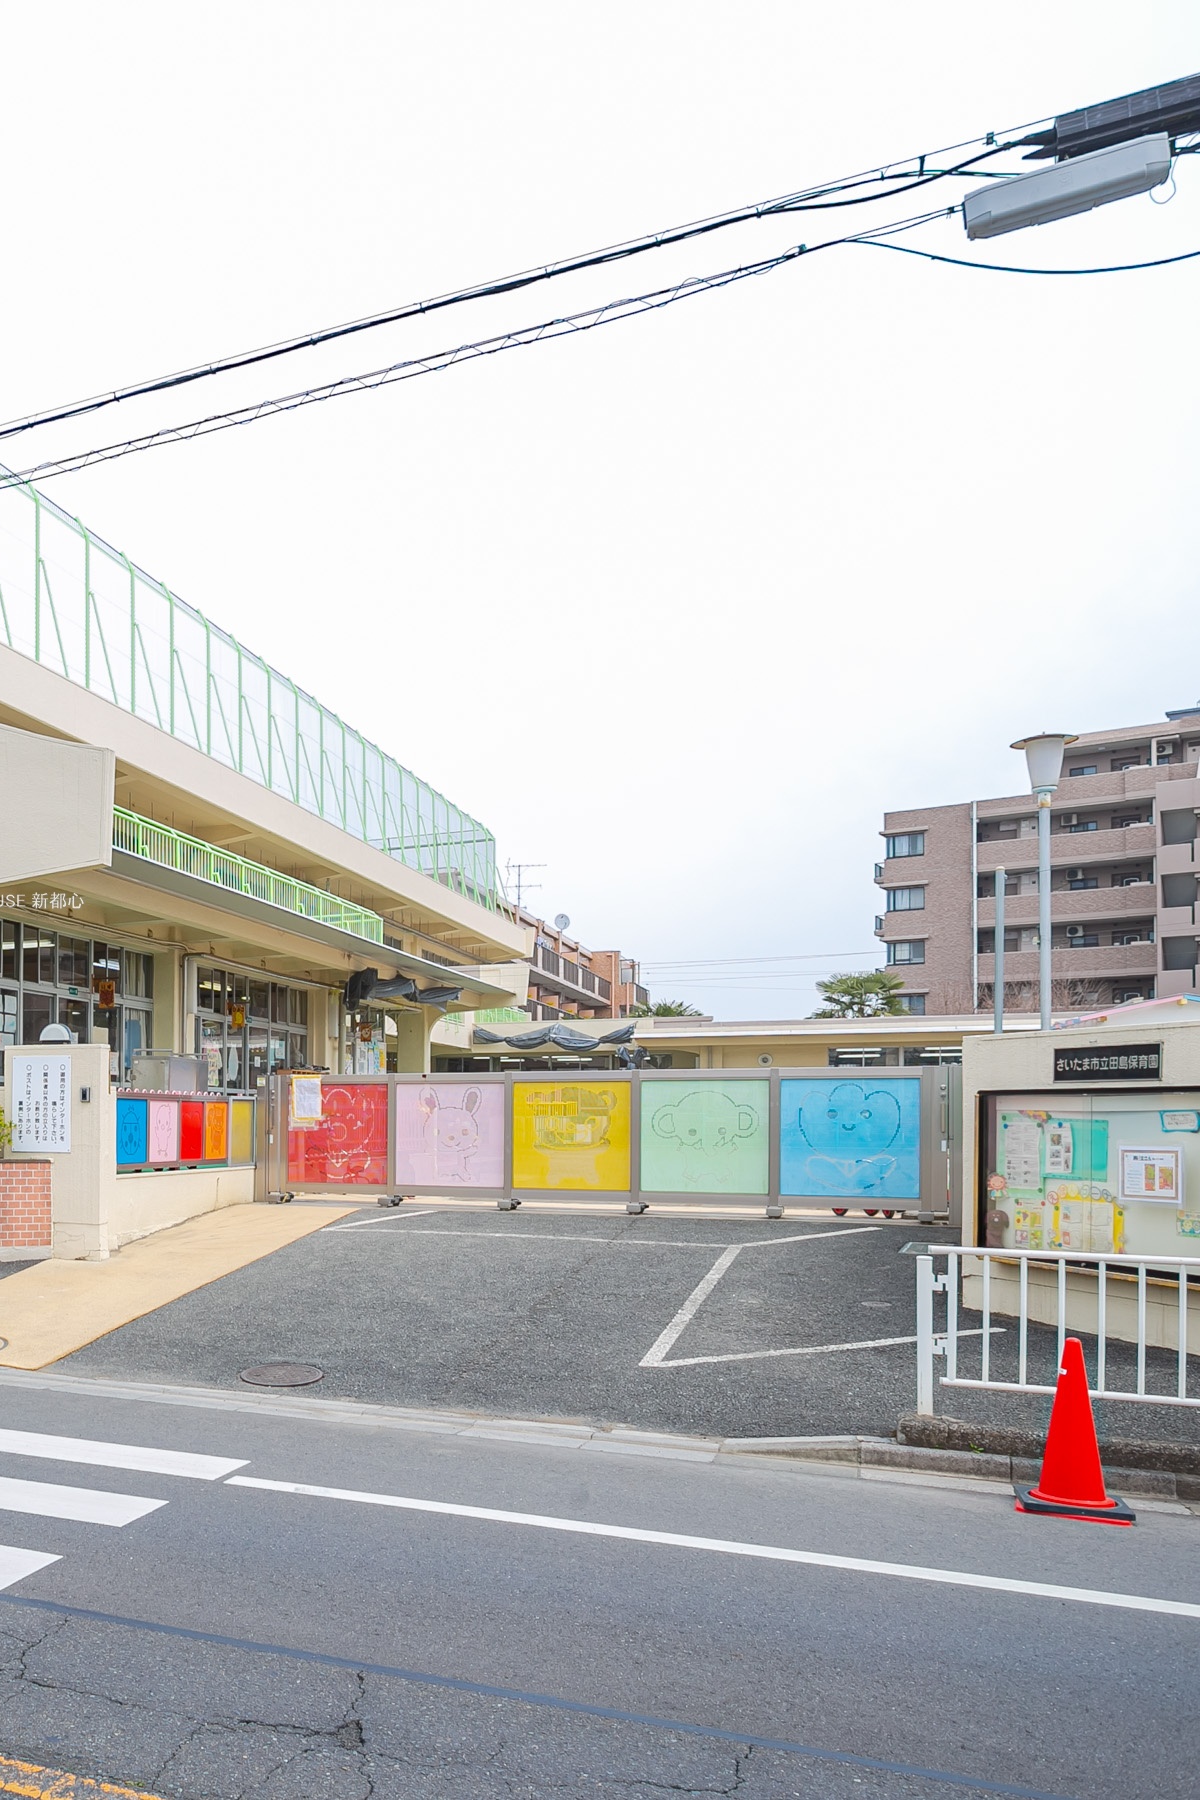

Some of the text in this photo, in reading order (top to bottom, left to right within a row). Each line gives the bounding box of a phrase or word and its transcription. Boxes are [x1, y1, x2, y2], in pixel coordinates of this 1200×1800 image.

[1056, 1054, 1159, 1071] さいたま市立田島保育園
